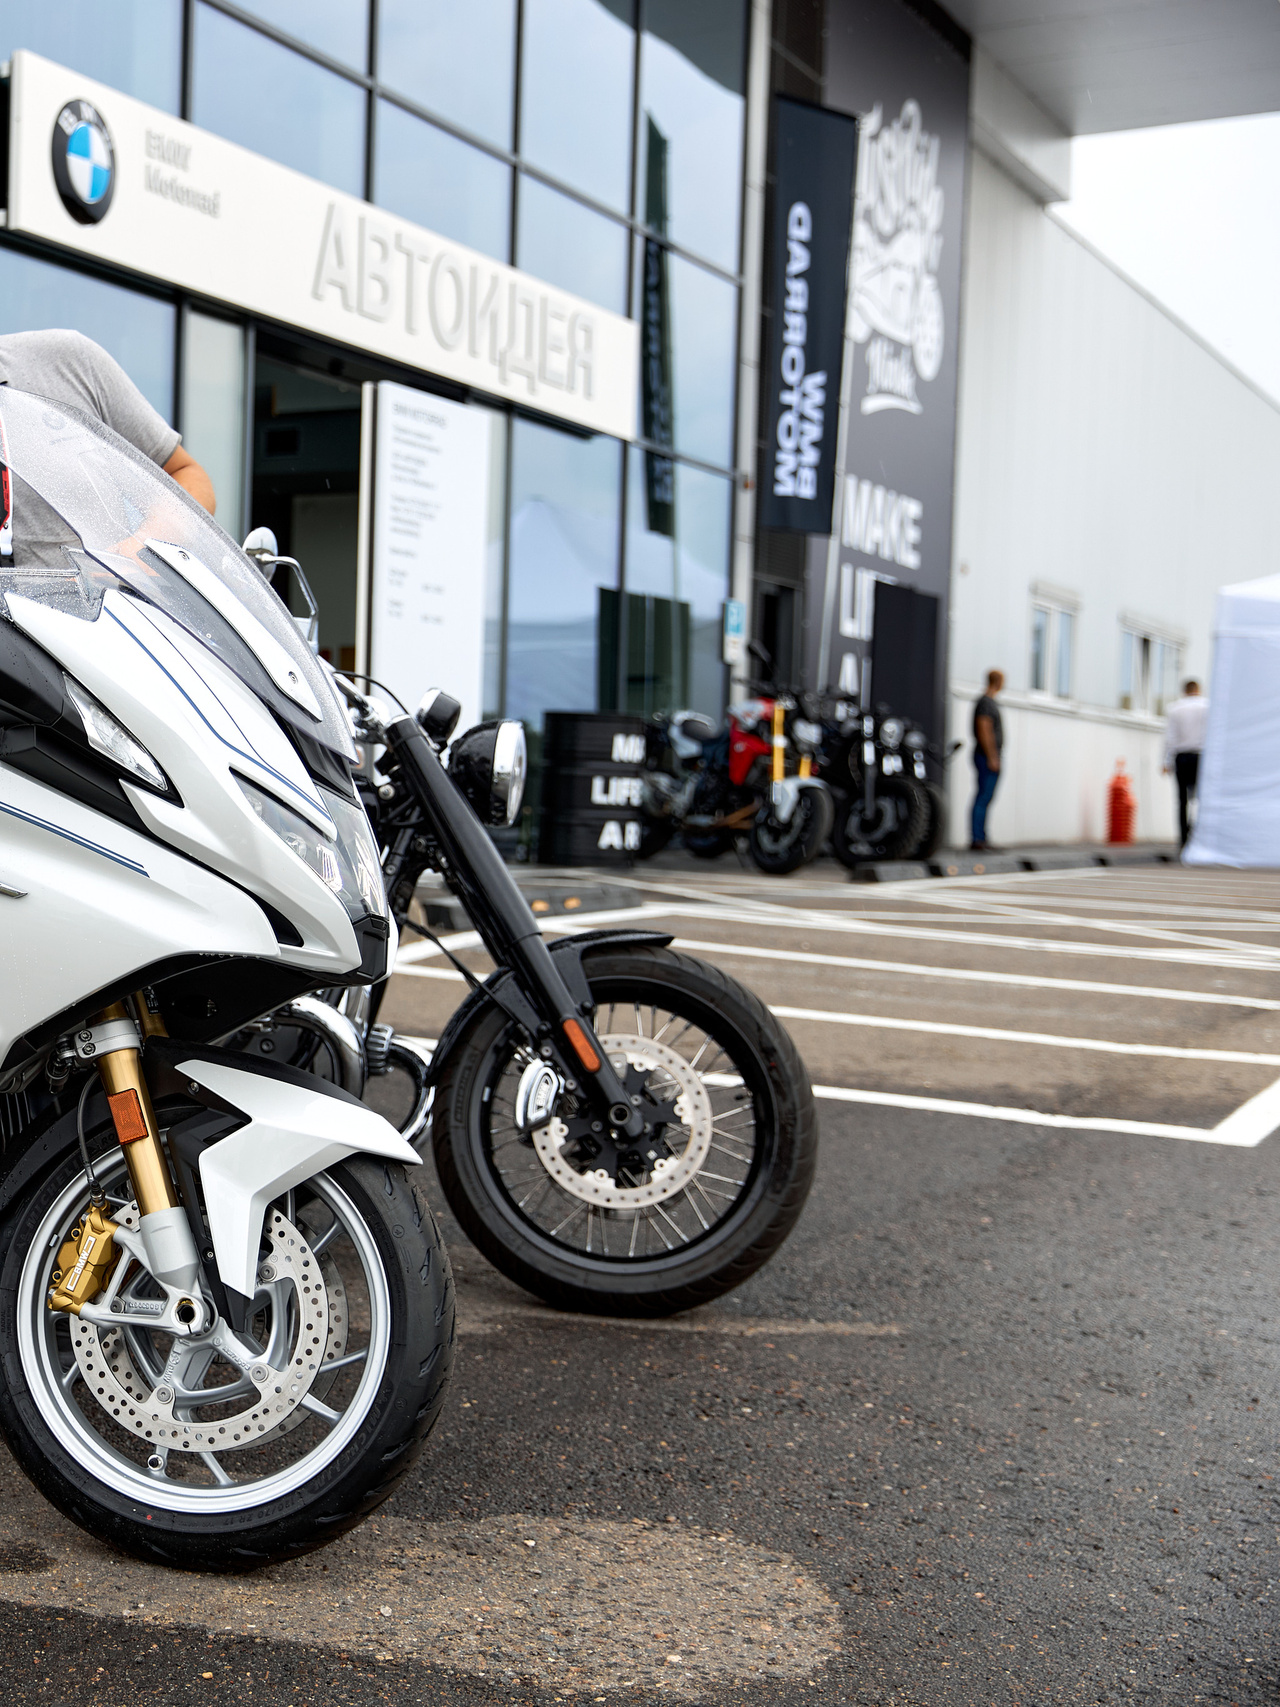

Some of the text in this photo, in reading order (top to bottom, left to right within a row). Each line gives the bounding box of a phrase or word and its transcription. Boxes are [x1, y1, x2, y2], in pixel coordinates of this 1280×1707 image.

[143, 129, 192, 172] BMW
[143, 163, 221, 219] Motorrad
[311, 199, 594, 401] АВТОИДЕЯ
[841, 473, 923, 570] MAKE
[73, 1249, 90, 1276] BMW
